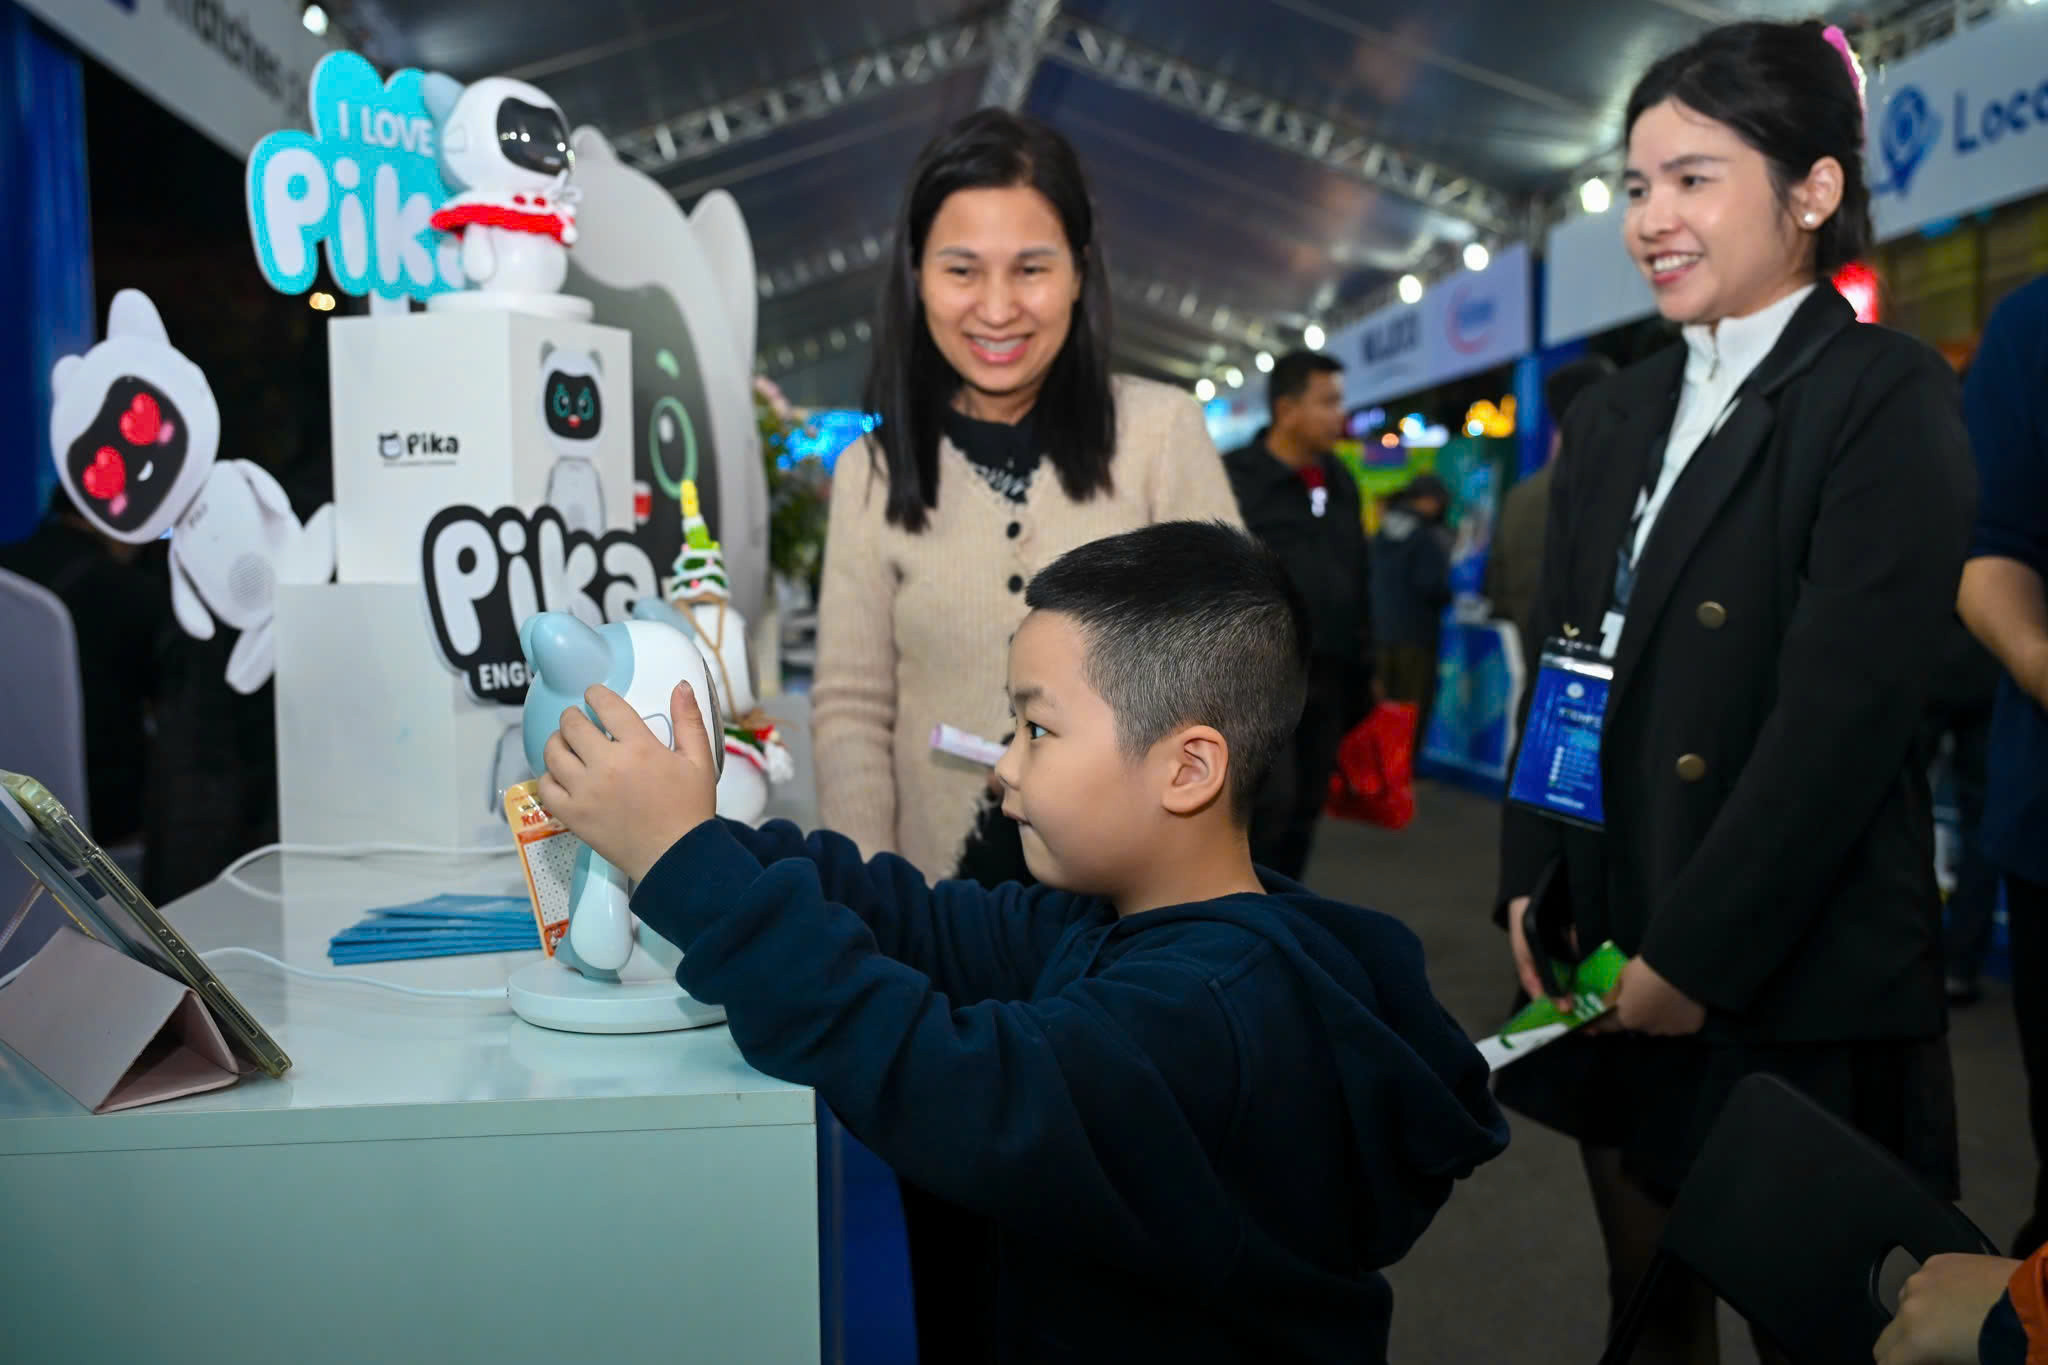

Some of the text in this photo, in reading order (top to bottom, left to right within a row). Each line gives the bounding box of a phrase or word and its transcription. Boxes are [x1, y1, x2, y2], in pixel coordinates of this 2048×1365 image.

[337, 101, 433, 157] I LOVE
[264, 148, 465, 288] Pik
[407, 432, 459, 455] Pika
[433, 518, 659, 656] Pika
